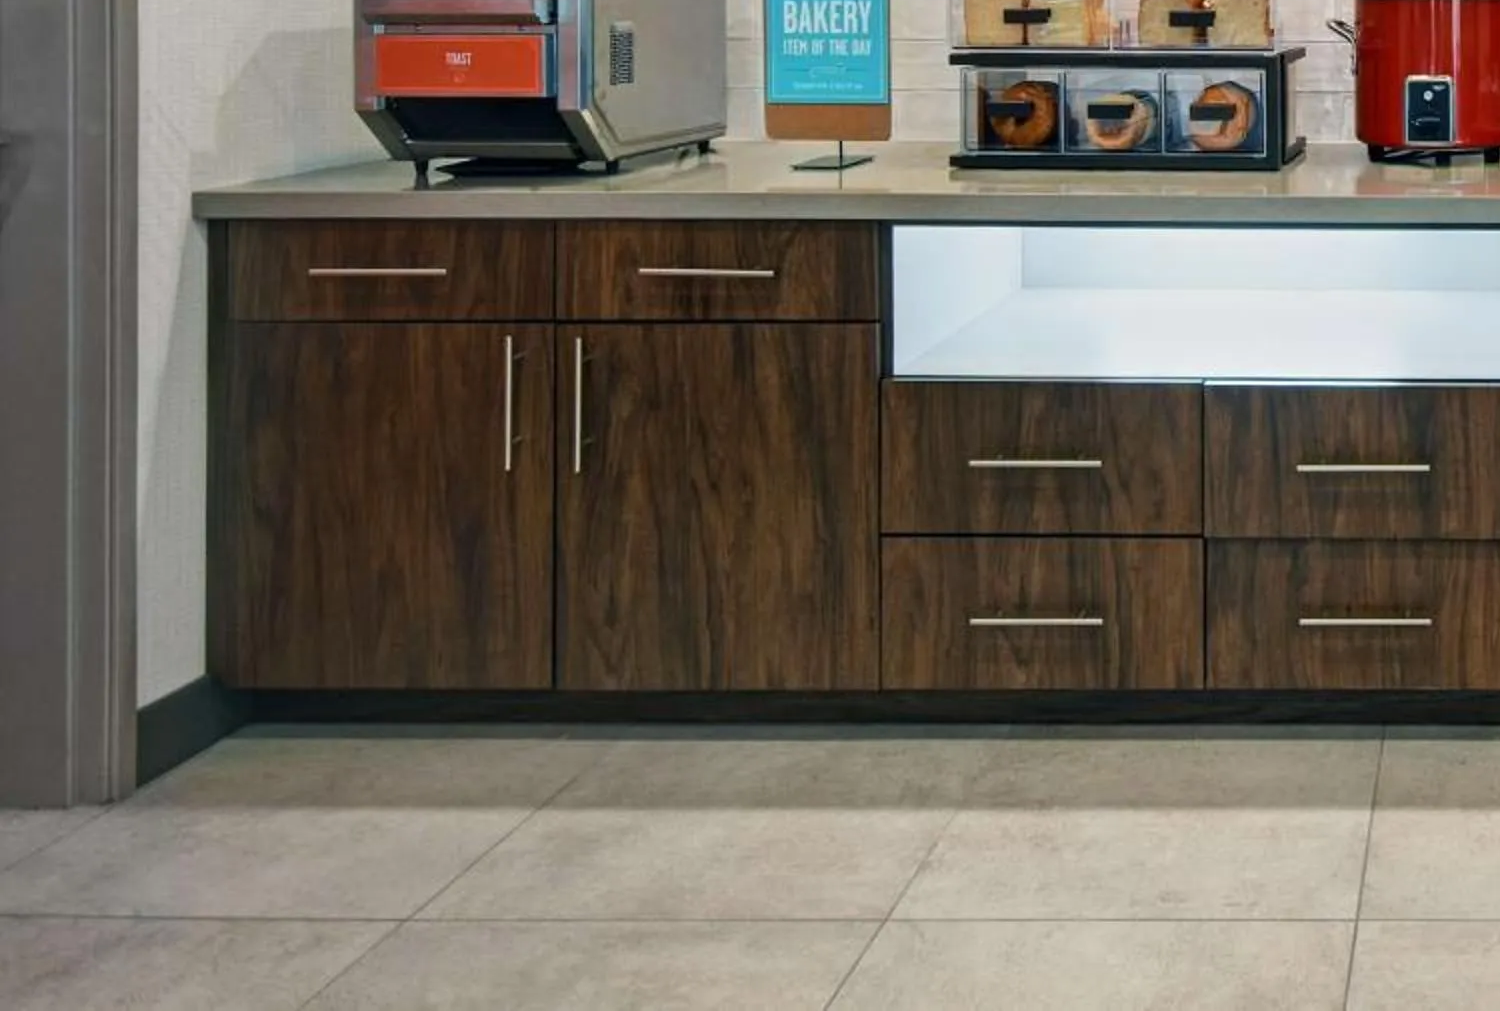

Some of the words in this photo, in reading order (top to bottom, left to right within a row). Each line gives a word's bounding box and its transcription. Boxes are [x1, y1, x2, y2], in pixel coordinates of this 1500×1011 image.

[783, 0, 873, 34] BAKERY
[783, 39, 808, 56] ITEM
[811, 39, 826, 56] OF
[829, 39, 849, 56] THE
